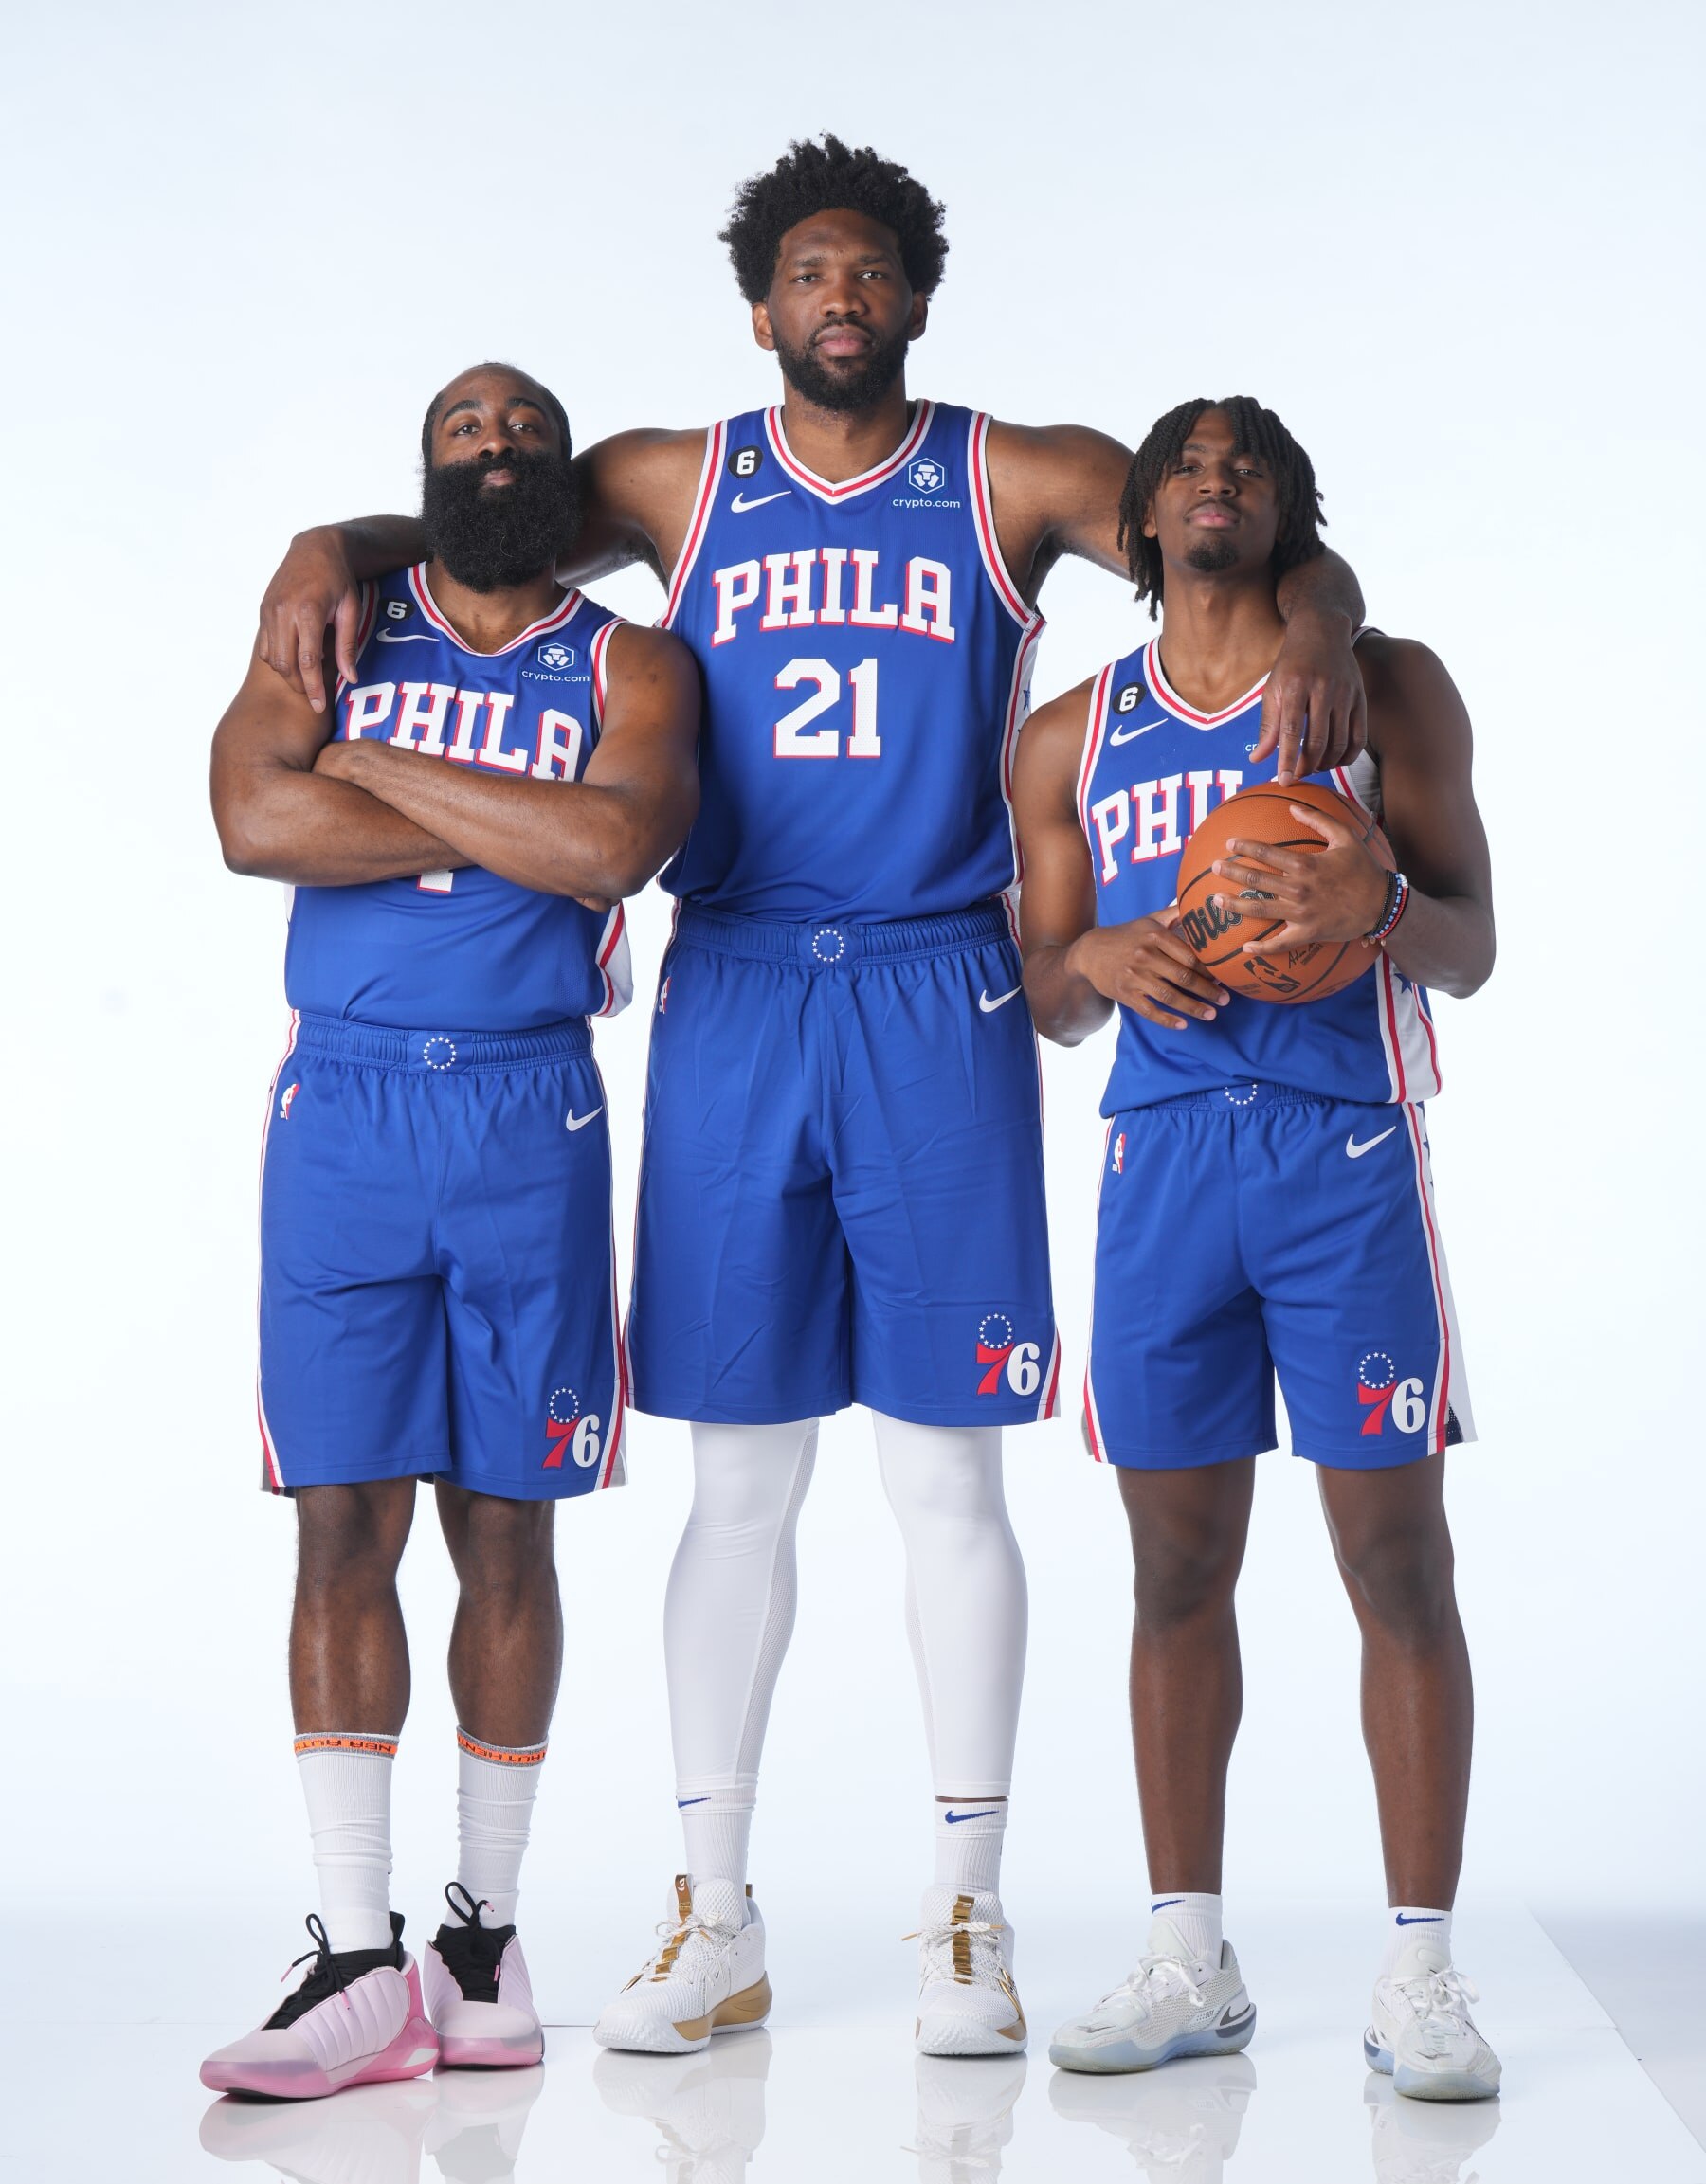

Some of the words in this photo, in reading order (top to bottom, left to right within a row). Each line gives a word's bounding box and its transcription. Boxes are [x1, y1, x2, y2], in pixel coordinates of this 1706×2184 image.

[736, 449, 756, 475] 6
[892, 493, 961, 509] crypto.com
[386, 601, 408, 620] 6
[711, 546, 955, 648] PHILA
[521, 670, 590, 682] crypto.com
[1118, 685, 1139, 713] 6
[345, 681, 583, 783] PHILA
[772, 658, 881, 759] 21
[1091, 769, 1243, 888] PHI
[975, 1341, 1041, 1396] 76
[1357, 1377, 1426, 1437] 76
[542, 1414, 600, 1470] 76
